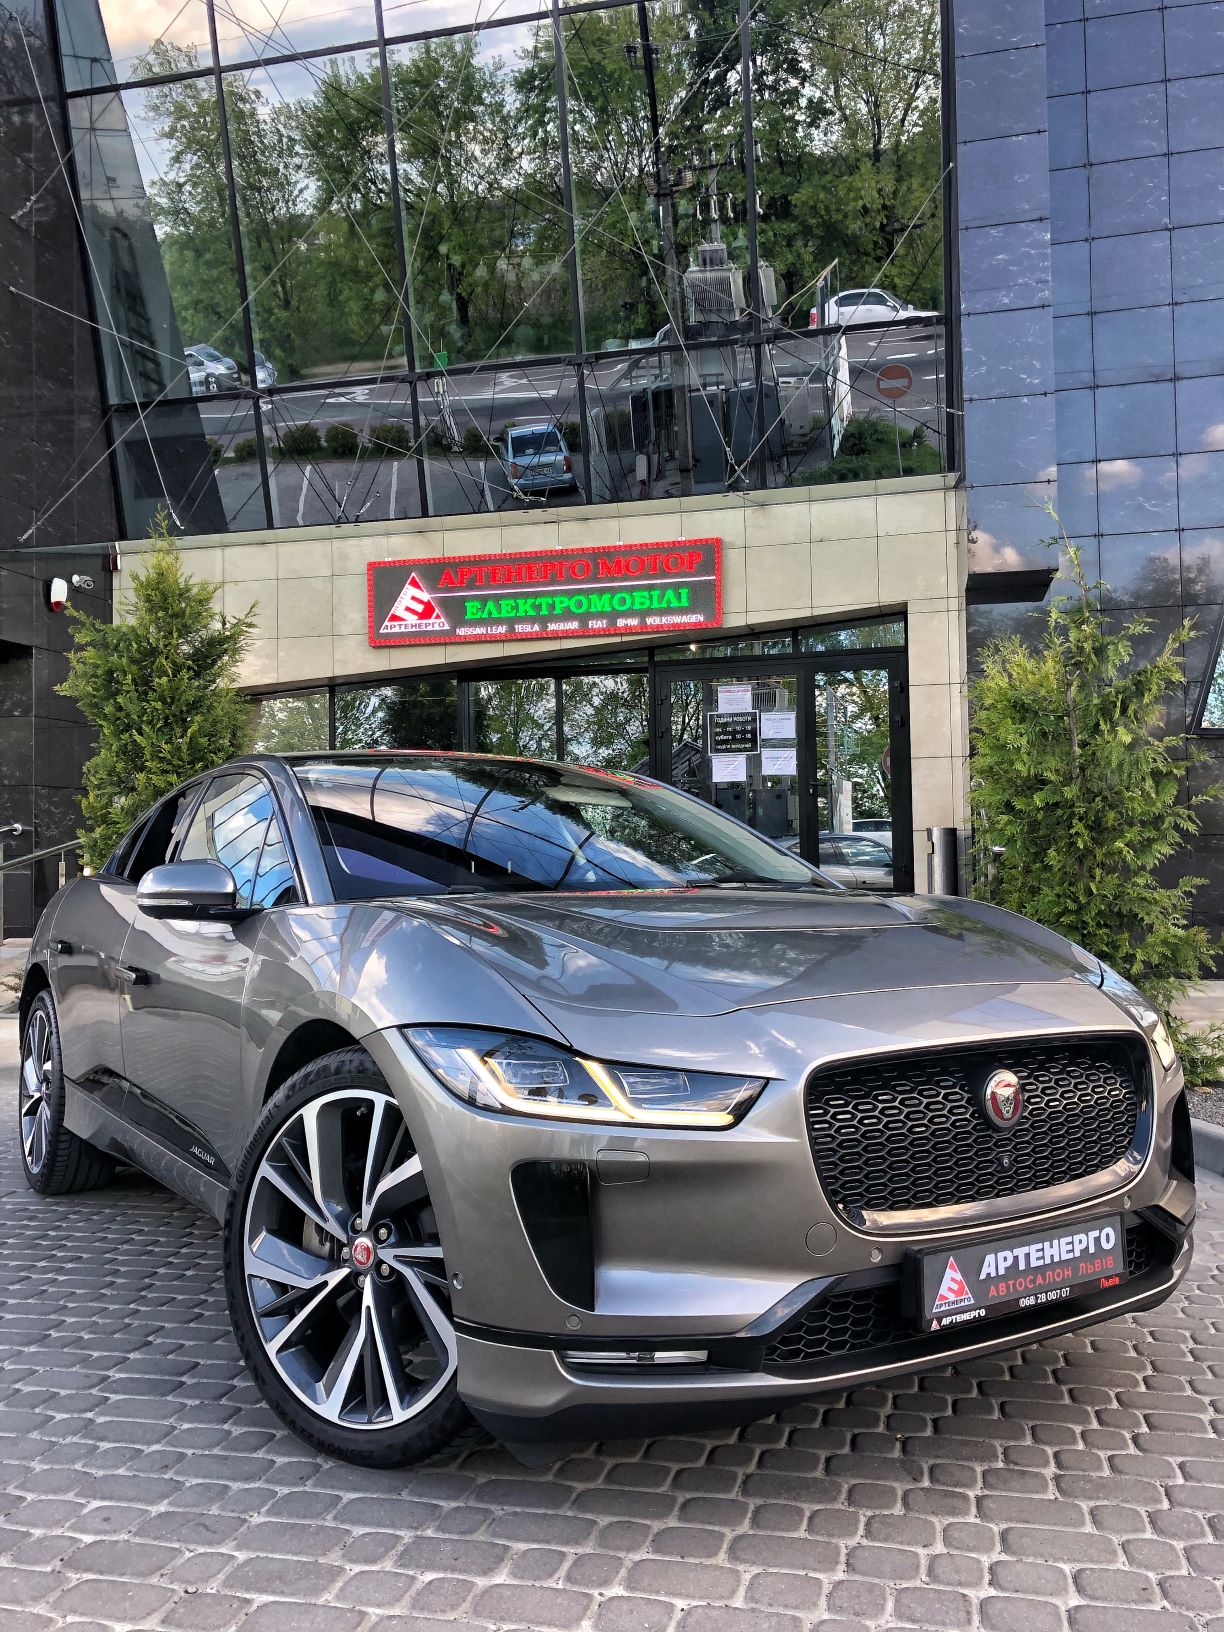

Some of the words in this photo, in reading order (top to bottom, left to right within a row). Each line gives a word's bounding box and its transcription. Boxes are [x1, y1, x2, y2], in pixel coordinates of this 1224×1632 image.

[437, 559, 592, 588] АРТЕНЕРГО
[597, 551, 704, 578] МОТОР
[464, 587, 689, 620] ЕЛЕКТРОМОБІЛІ
[382, 621, 446, 631] АРТЕНЕРГО
[456, 627, 487, 635] NISSAN
[488, 625, 508, 634] LEAF
[514, 623, 540, 632] TESLA
[547, 622, 579, 630] JAGUAR
[589, 620, 608, 628] FIAT
[617, 618, 638, 626] BMW
[645, 614, 704, 625] VOLKSWAGEN
[190, 1145, 215, 1165] JAGUAR
[979, 1226, 1116, 1280] АРТЕНЕРГО
[988, 1266, 1073, 1298] АВТОСАЛОН
[1078, 1256, 1115, 1277] ЛЬВІВ
[934, 1296, 972, 1311] АРТЕНЕРГО
[1037, 1292, 1046, 1303] 28
[1047, 1289, 1060, 1301] 007
[1061, 1287, 1070, 1298] 07
[940, 1308, 986, 1326] АРТЕНЕРГО
